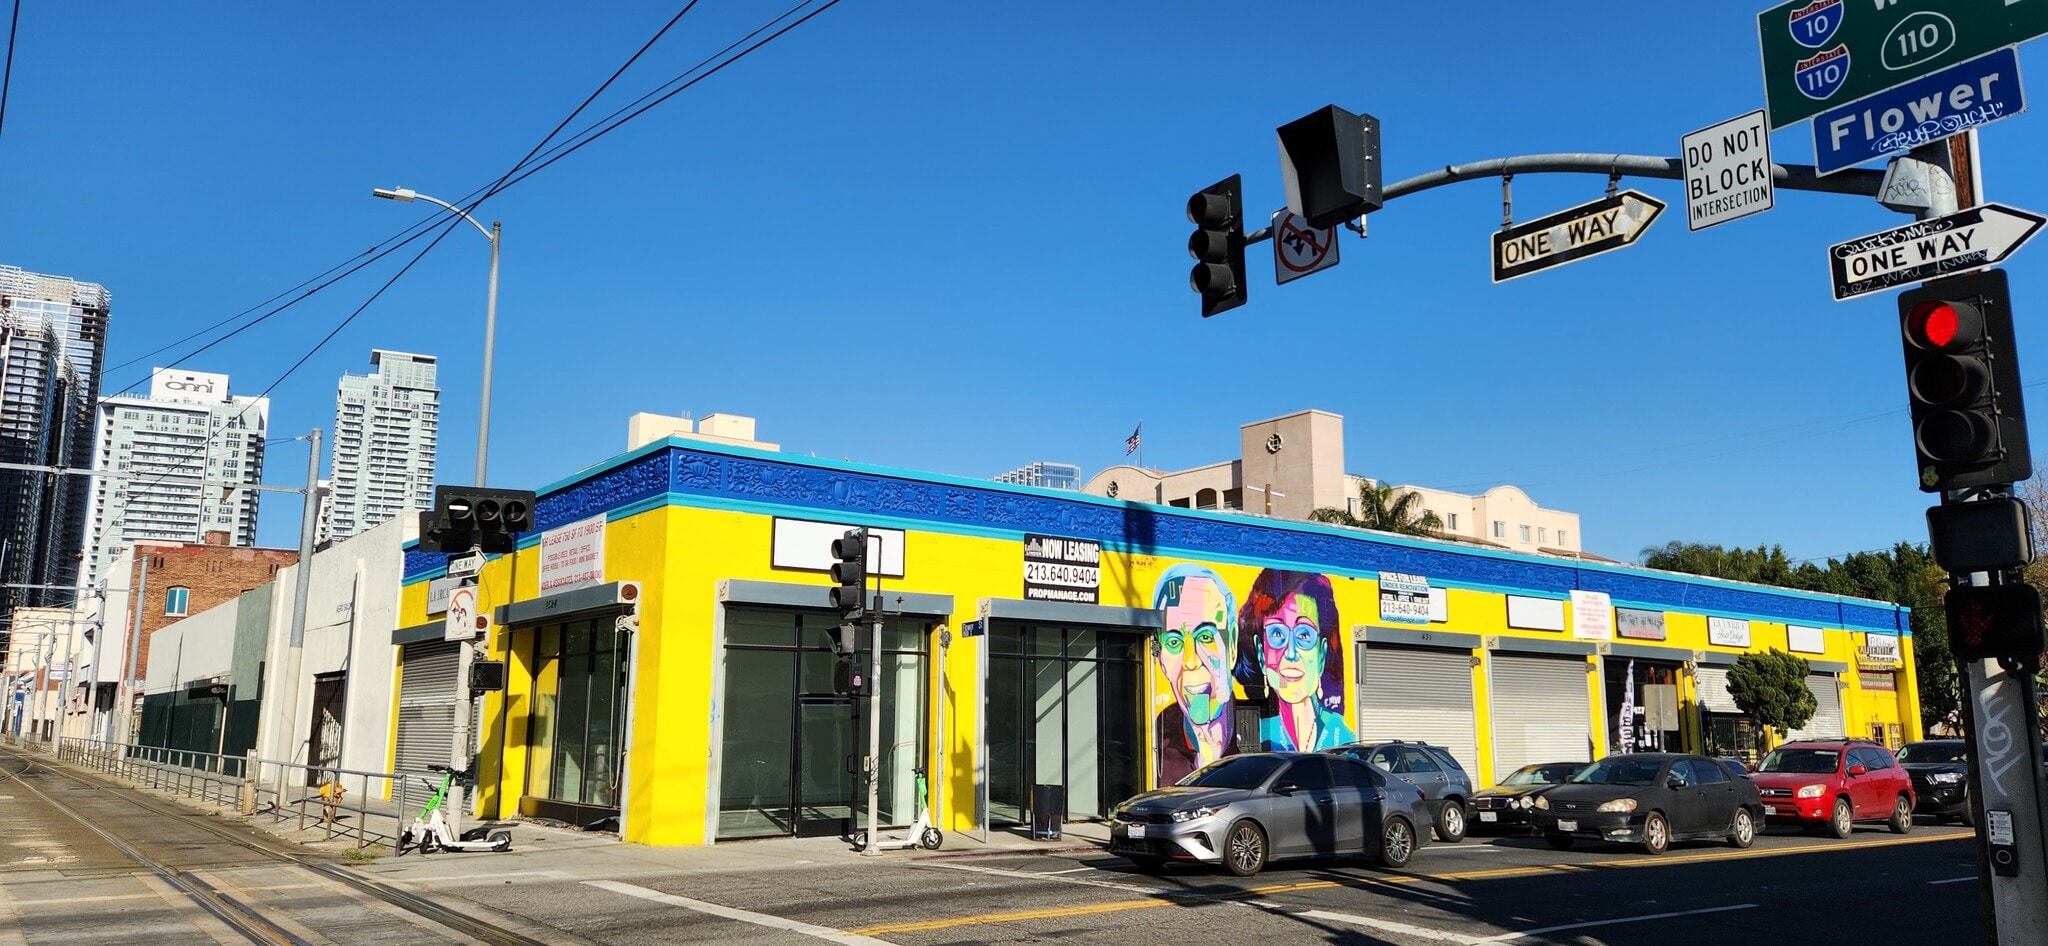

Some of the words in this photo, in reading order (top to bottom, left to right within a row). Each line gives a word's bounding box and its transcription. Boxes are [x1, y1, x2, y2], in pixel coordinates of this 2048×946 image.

[1806, 15, 1828, 37] 10
[1898, 23, 1939, 56] 110
[1799, 49, 1842, 69] INTERSTATE
[1807, 64, 1840, 91] 110
[1830, 72, 2000, 151] Flower
[1688, 142, 1712, 168] DO
[1723, 125, 1761, 157] NOT
[1690, 158, 1766, 200] BLOCK
[1692, 185, 1769, 221] INTERSECTION
[1505, 231, 1551, 263] ONE
[1568, 209, 1622, 246] WAY
[1852, 246, 1907, 276] ONE
[1917, 228, 1976, 261] WAY
[1042, 538, 1063, 560] NOW
[1064, 541, 1099, 563] LEASING
[1027, 563, 1097, 585] 213.640.9404
[1382, 581, 1398, 589] UNDER
[1400, 583, 1428, 593] RENOVATION
[1028, 588, 1095, 602] PROPMANAGE.COM
[1383, 602, 1429, 616] 213-640-9404
[1722, 620, 1745, 630] UNIQUE
